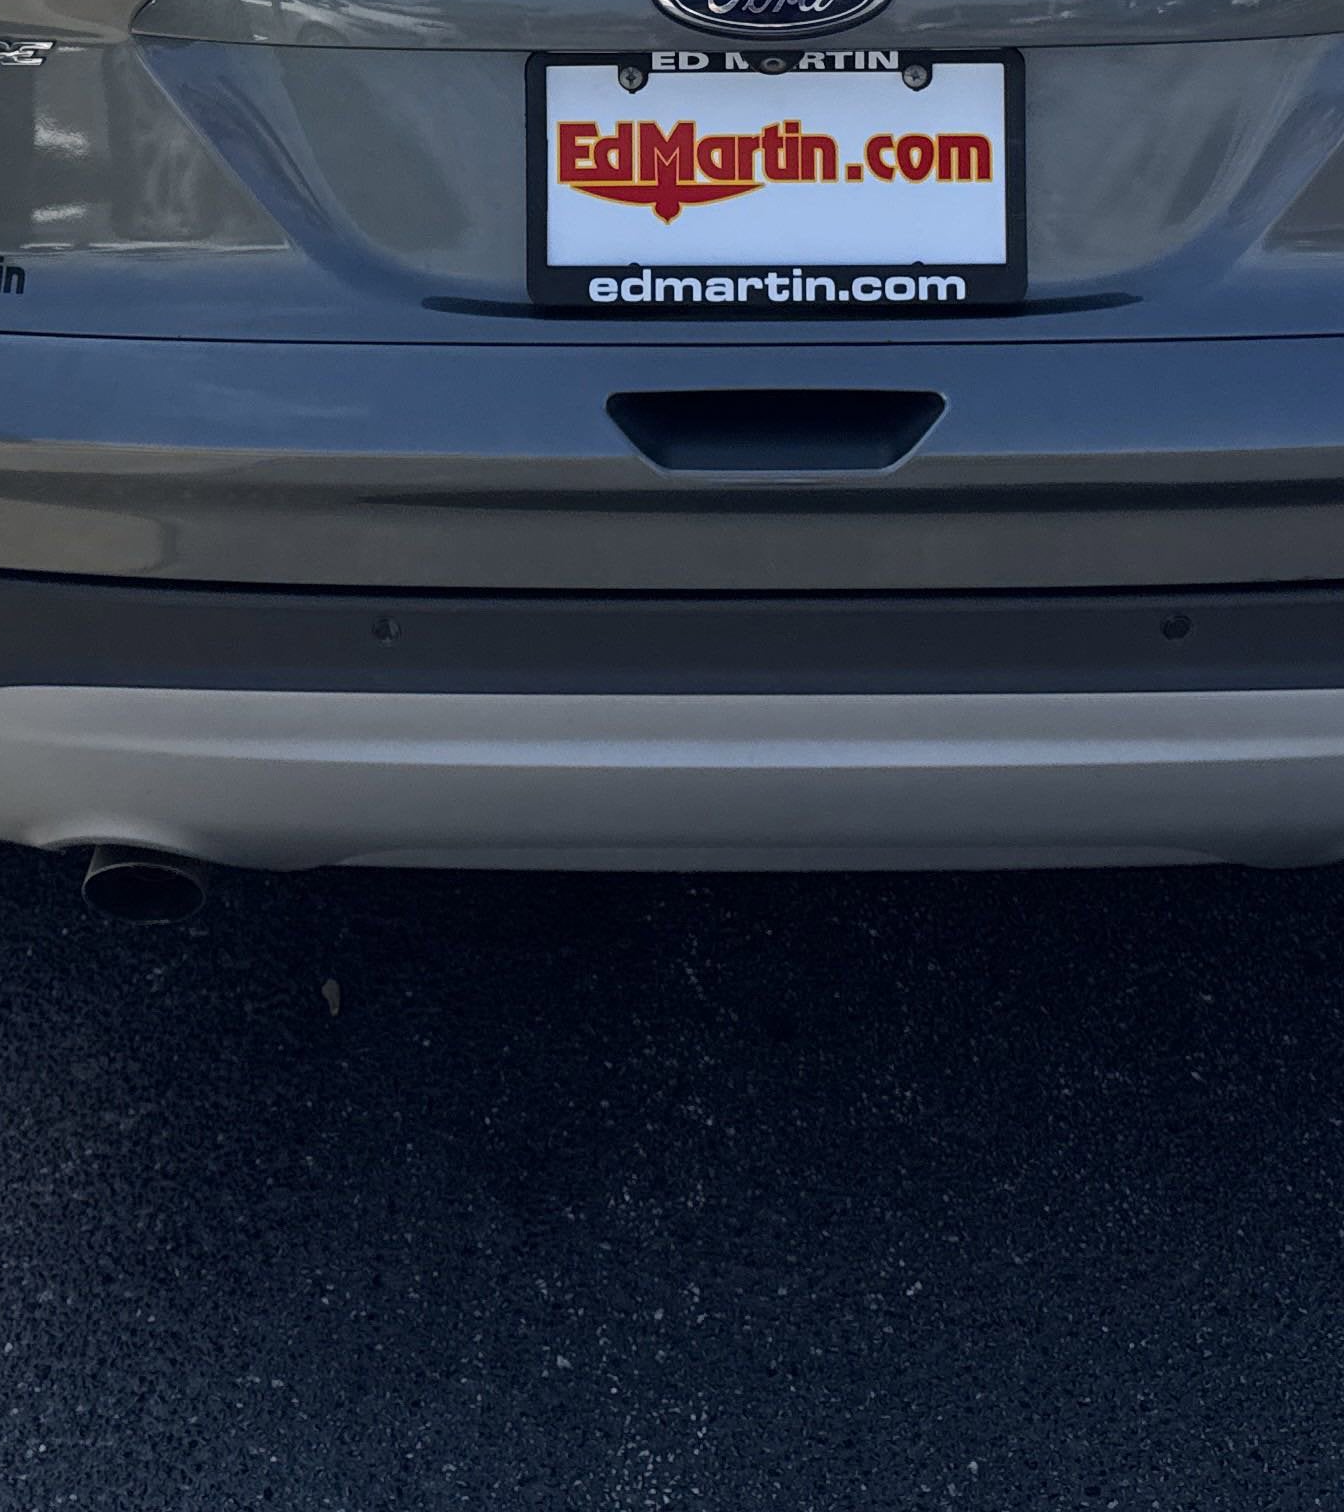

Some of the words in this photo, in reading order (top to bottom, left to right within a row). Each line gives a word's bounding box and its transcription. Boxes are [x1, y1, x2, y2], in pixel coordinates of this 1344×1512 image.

[651, 51, 710, 70] ED
[725, 51, 899, 71] MRTIN
[588, 269, 967, 303] edmartin.com
